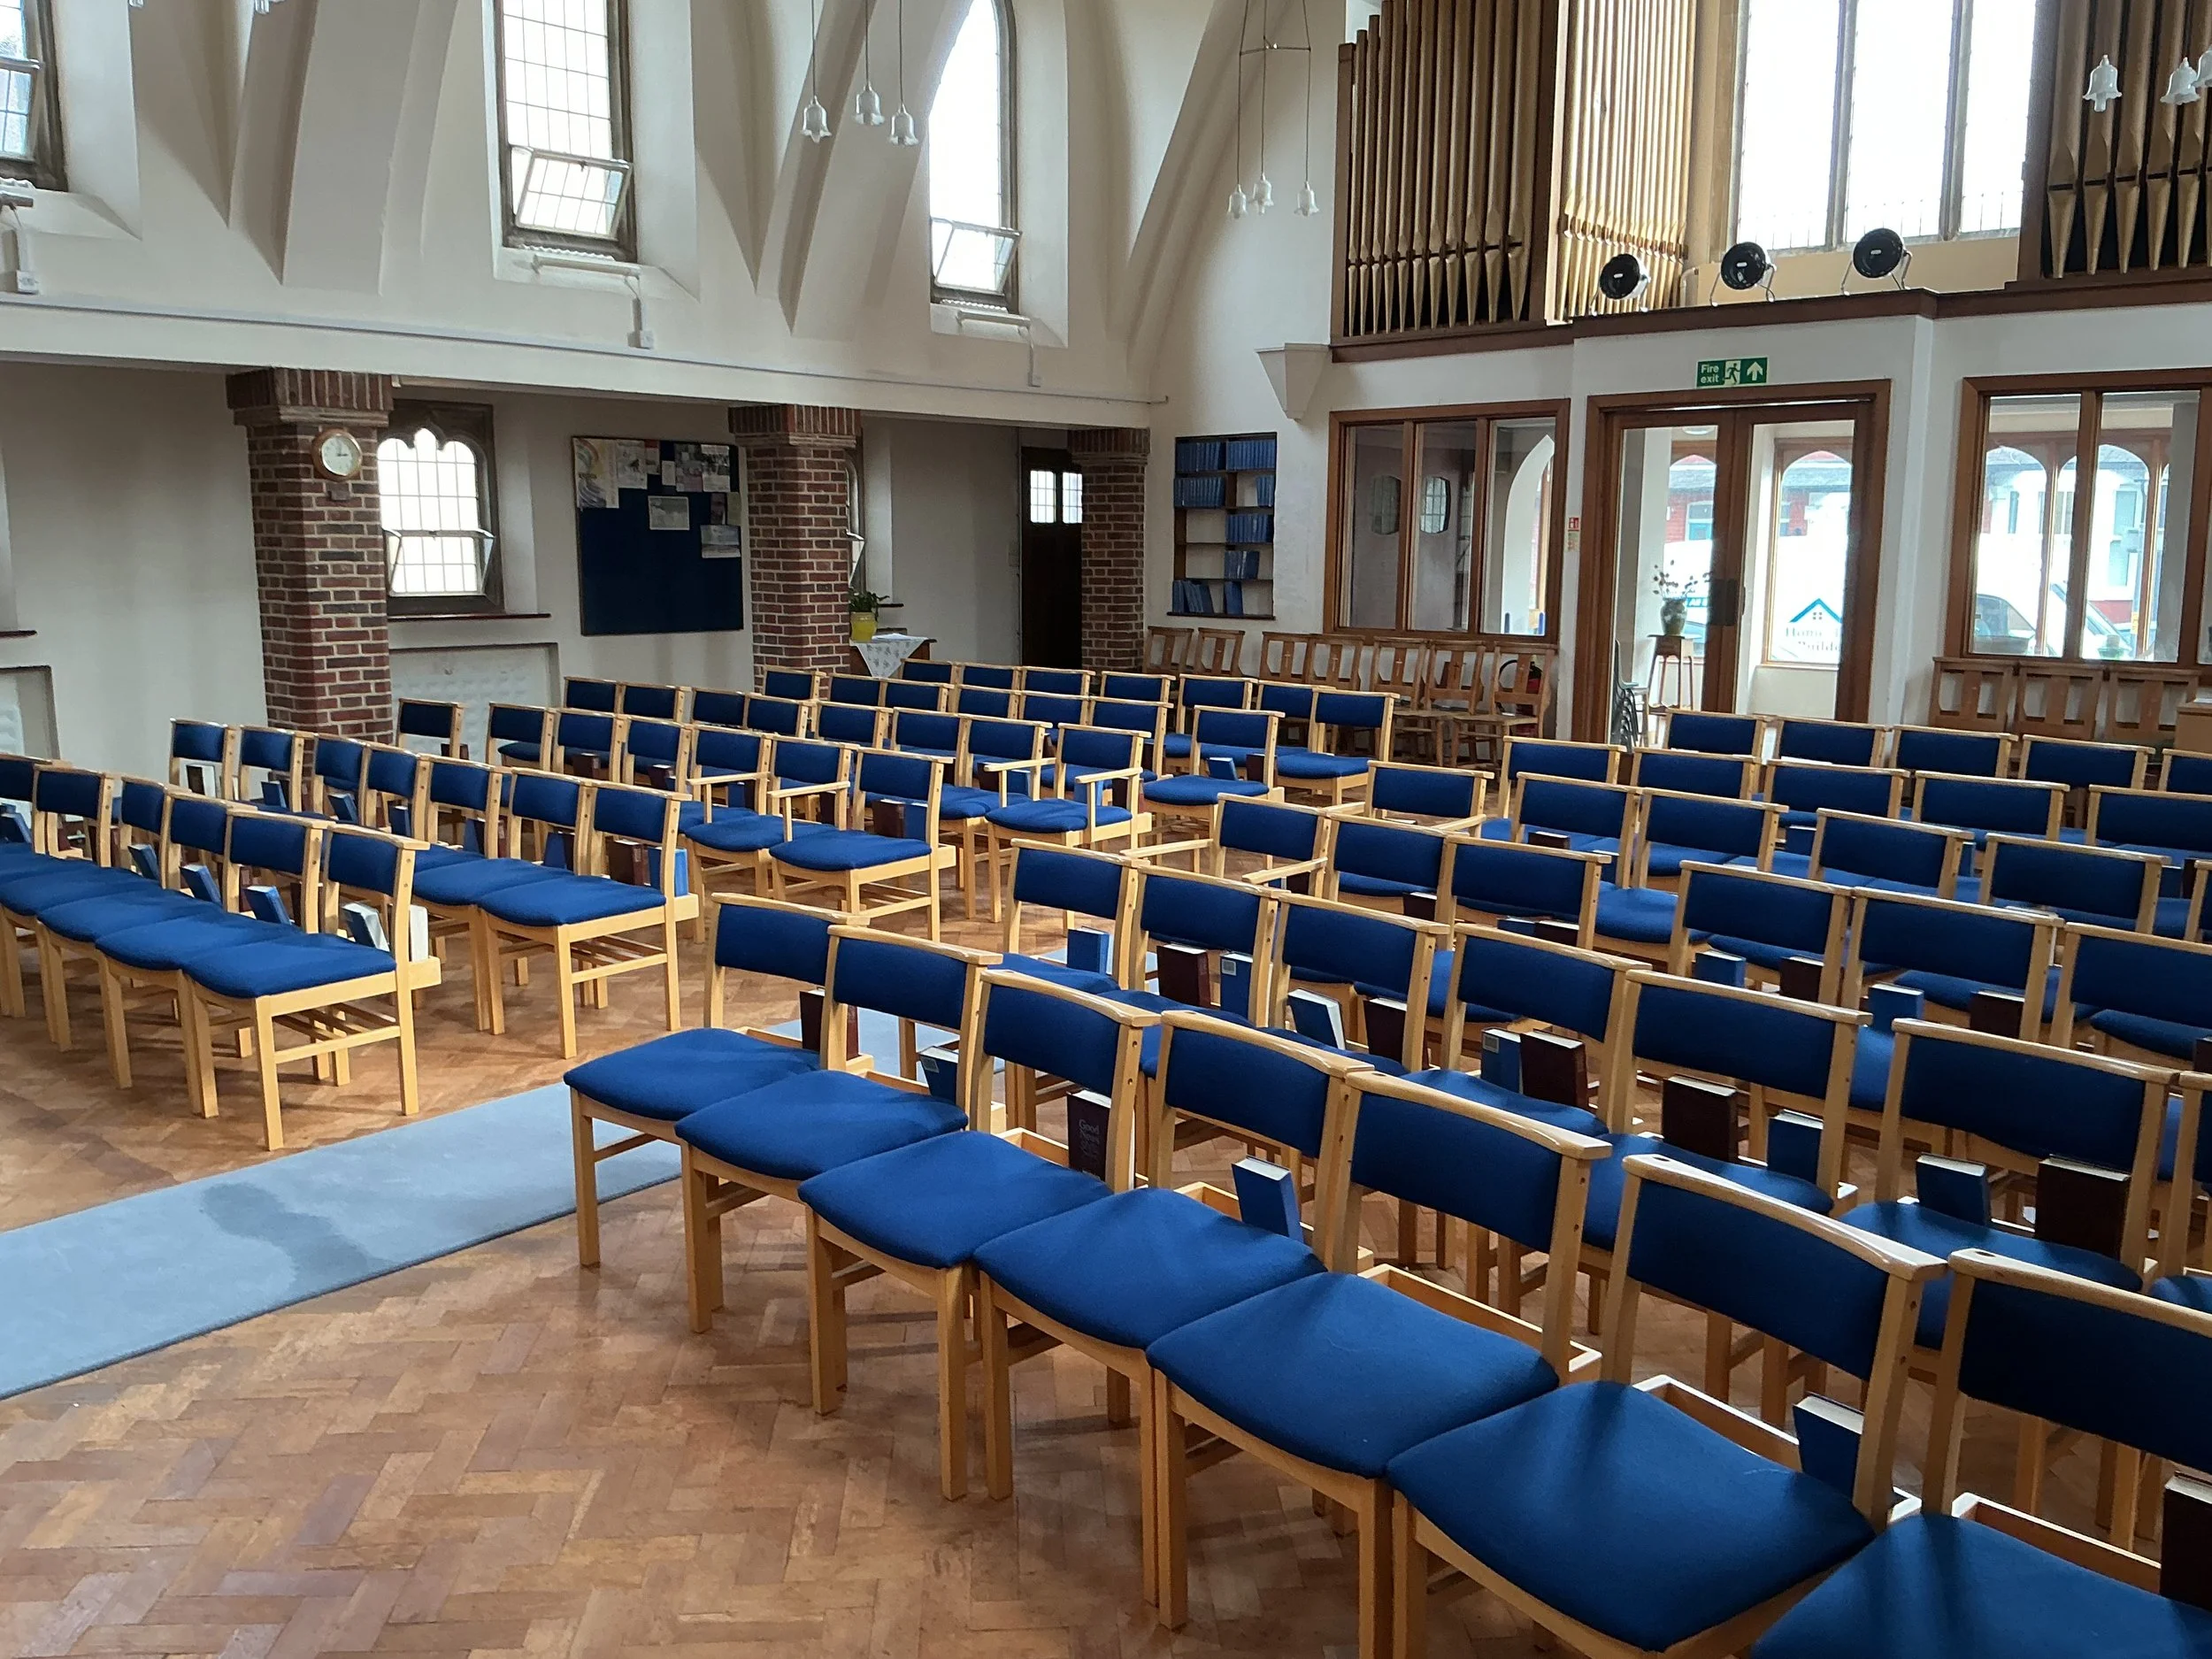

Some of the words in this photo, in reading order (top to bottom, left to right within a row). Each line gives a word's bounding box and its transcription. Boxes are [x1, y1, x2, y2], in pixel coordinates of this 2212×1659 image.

[1701, 364, 1719, 373] Fire
[1701, 374, 1719, 383] exit
[1079, 1118, 1100, 1135] Good
